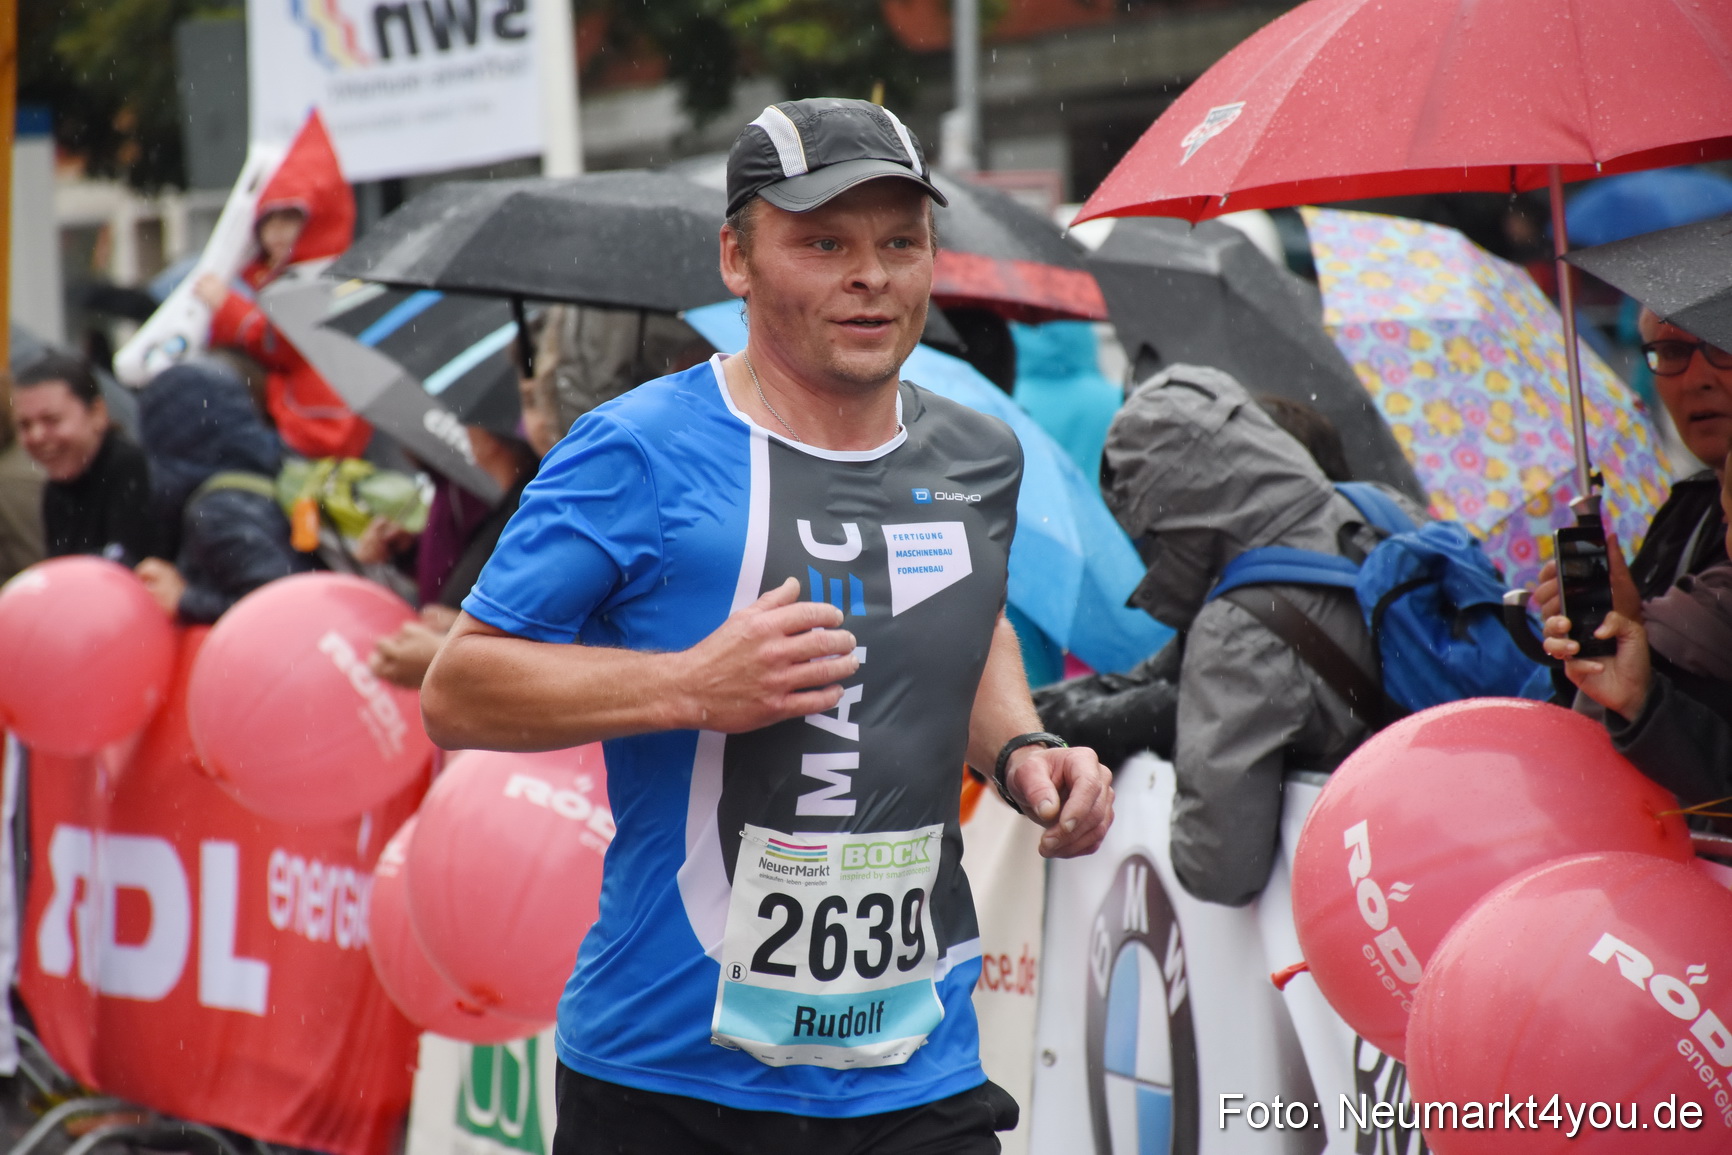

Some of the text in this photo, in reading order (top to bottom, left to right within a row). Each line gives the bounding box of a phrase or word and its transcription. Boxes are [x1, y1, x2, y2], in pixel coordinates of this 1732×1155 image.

[892, 532, 943, 541] FERTIGUNG
[895, 548, 953, 558] MASCHINENBAU
[897, 565, 944, 575] FORMENBAU
[841, 837, 930, 871] BOCK
[758, 856, 830, 877] NeuerMarkt
[840, 871, 871, 881] inspired
[873, 871, 883, 880] by
[750, 888, 926, 982] 2639
[1090, 863, 1188, 1017] BMW
[731, 964, 742, 979] B
[793, 1001, 885, 1039] Rudolf
